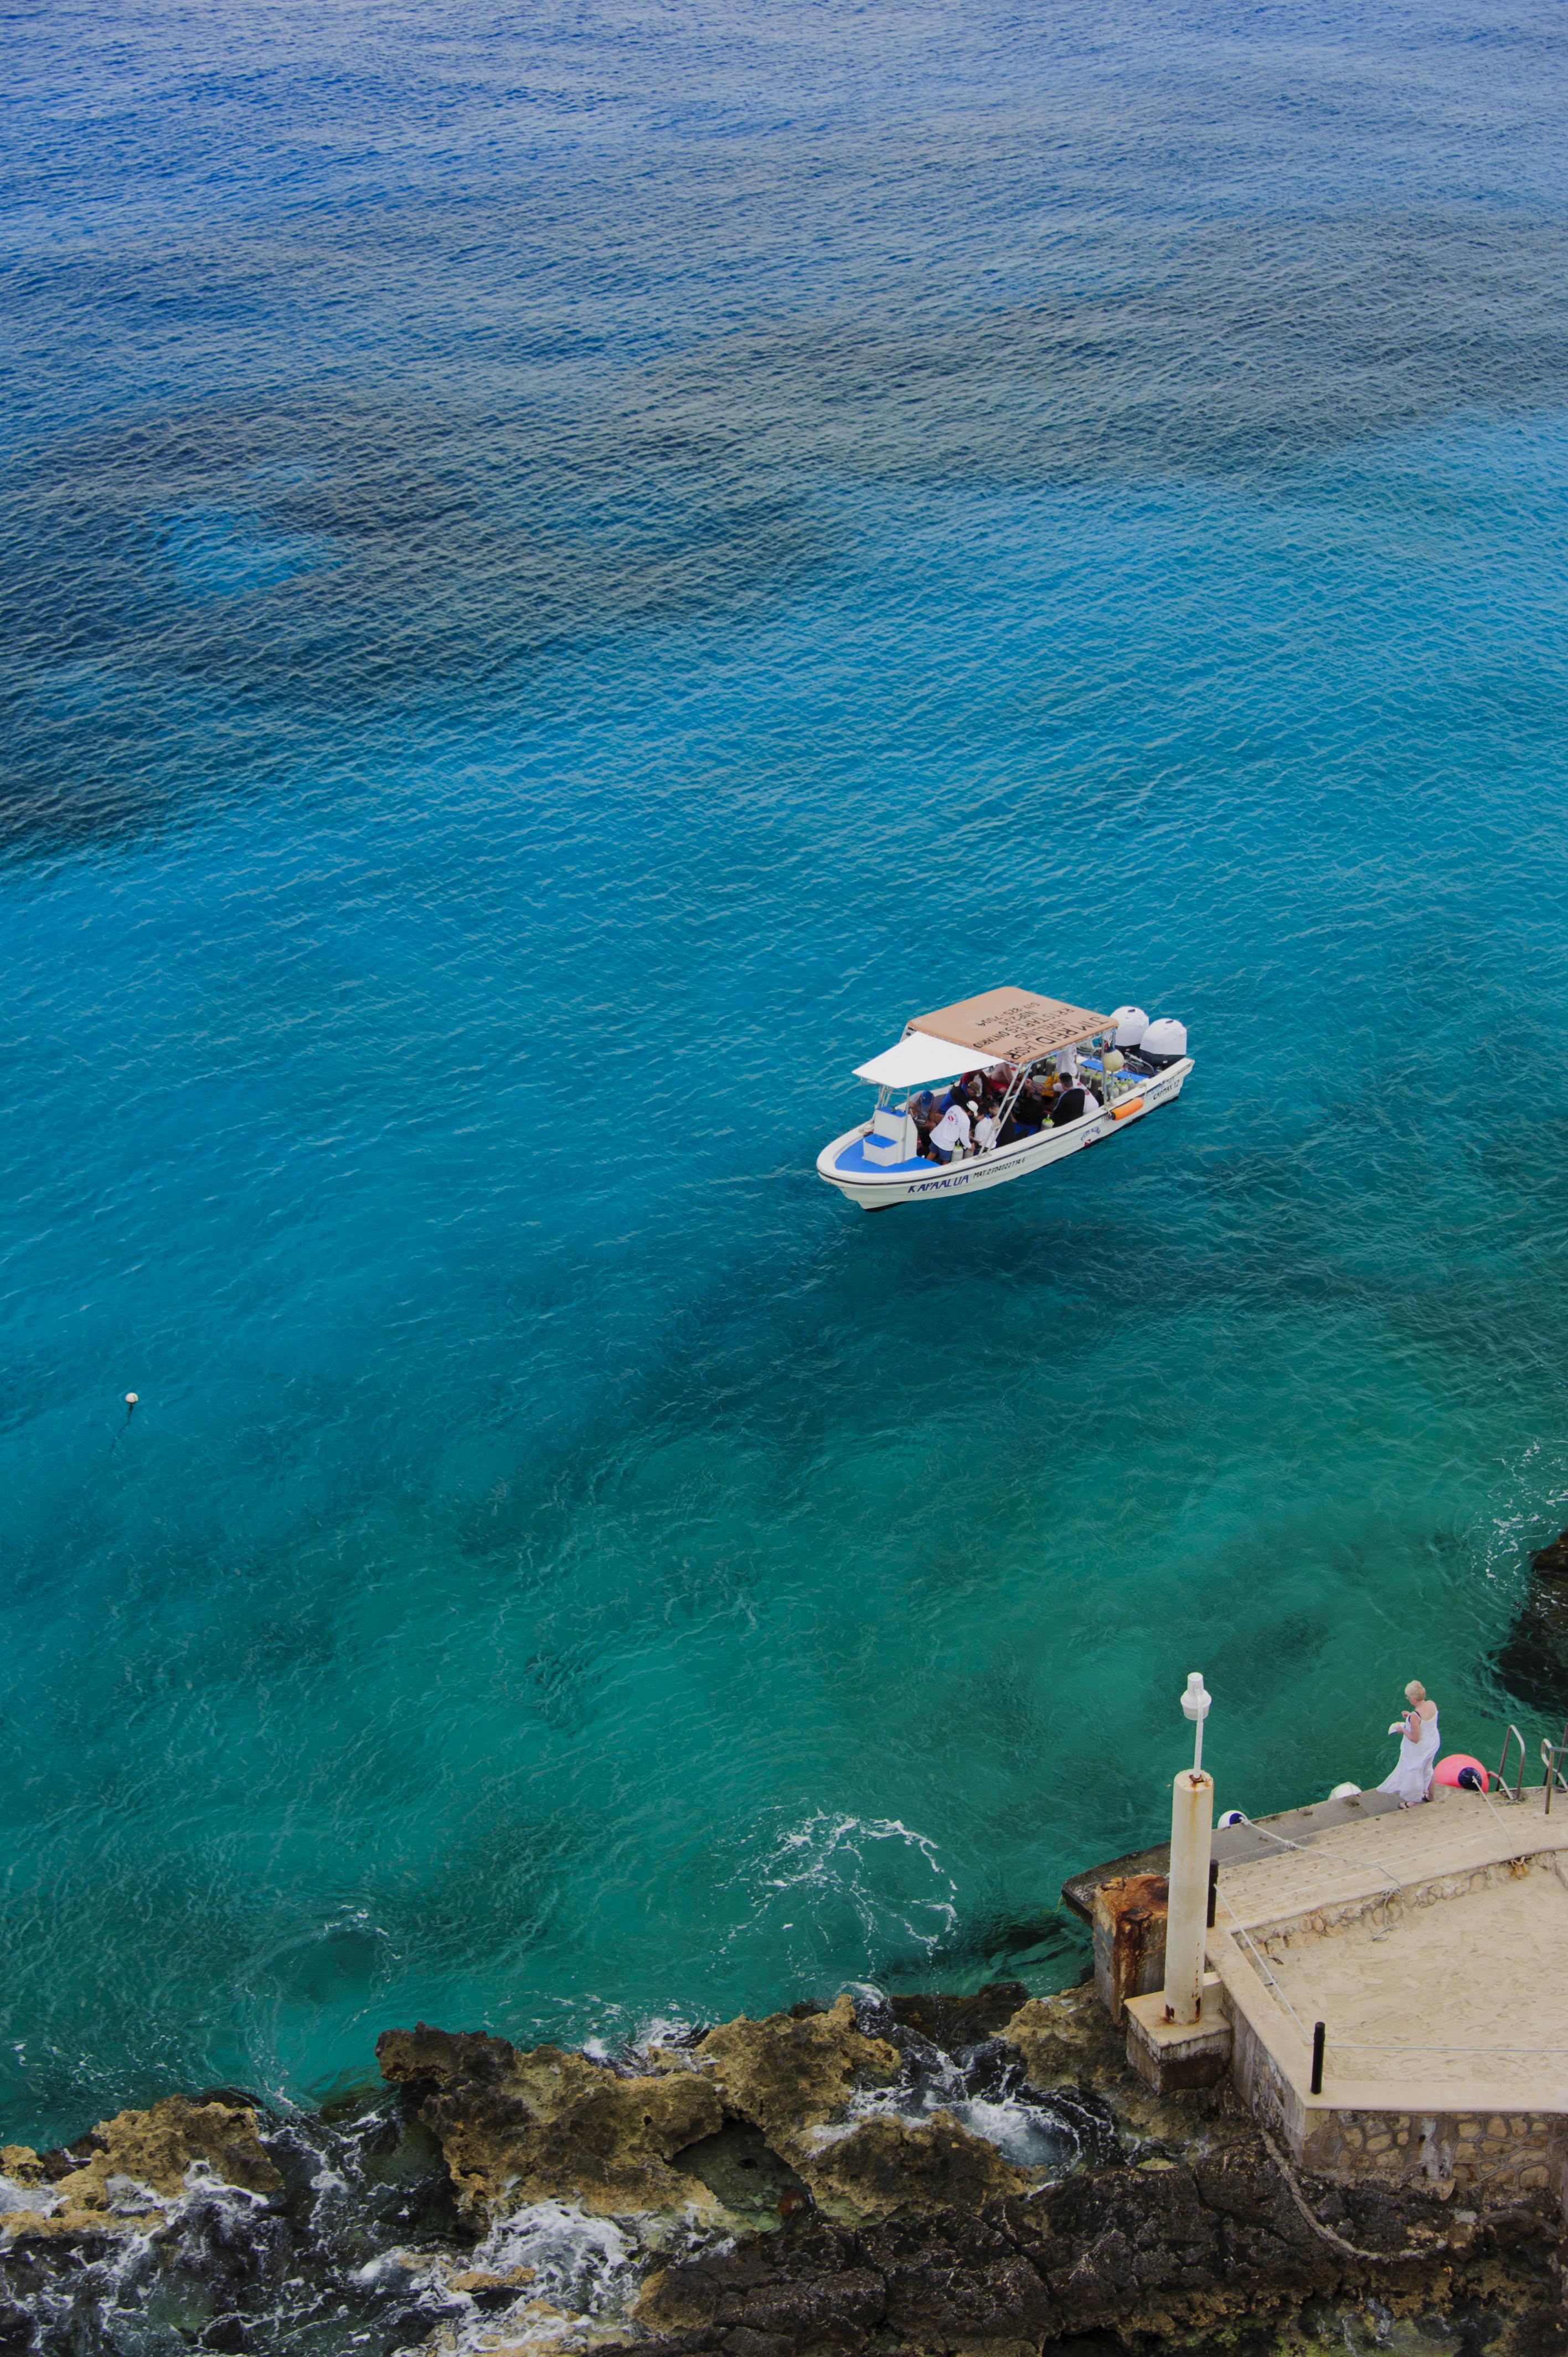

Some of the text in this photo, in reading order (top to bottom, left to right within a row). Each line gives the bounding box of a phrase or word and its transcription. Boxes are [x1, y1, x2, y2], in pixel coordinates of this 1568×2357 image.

[973, 1031, 1010, 1048] ONTARIO
[1003, 1016, 1108, 1059] JIM REID LASER
[1014, 1020, 1070, 1040] LEVELLING
[907, 1175, 969, 1193] KAPAALUA
